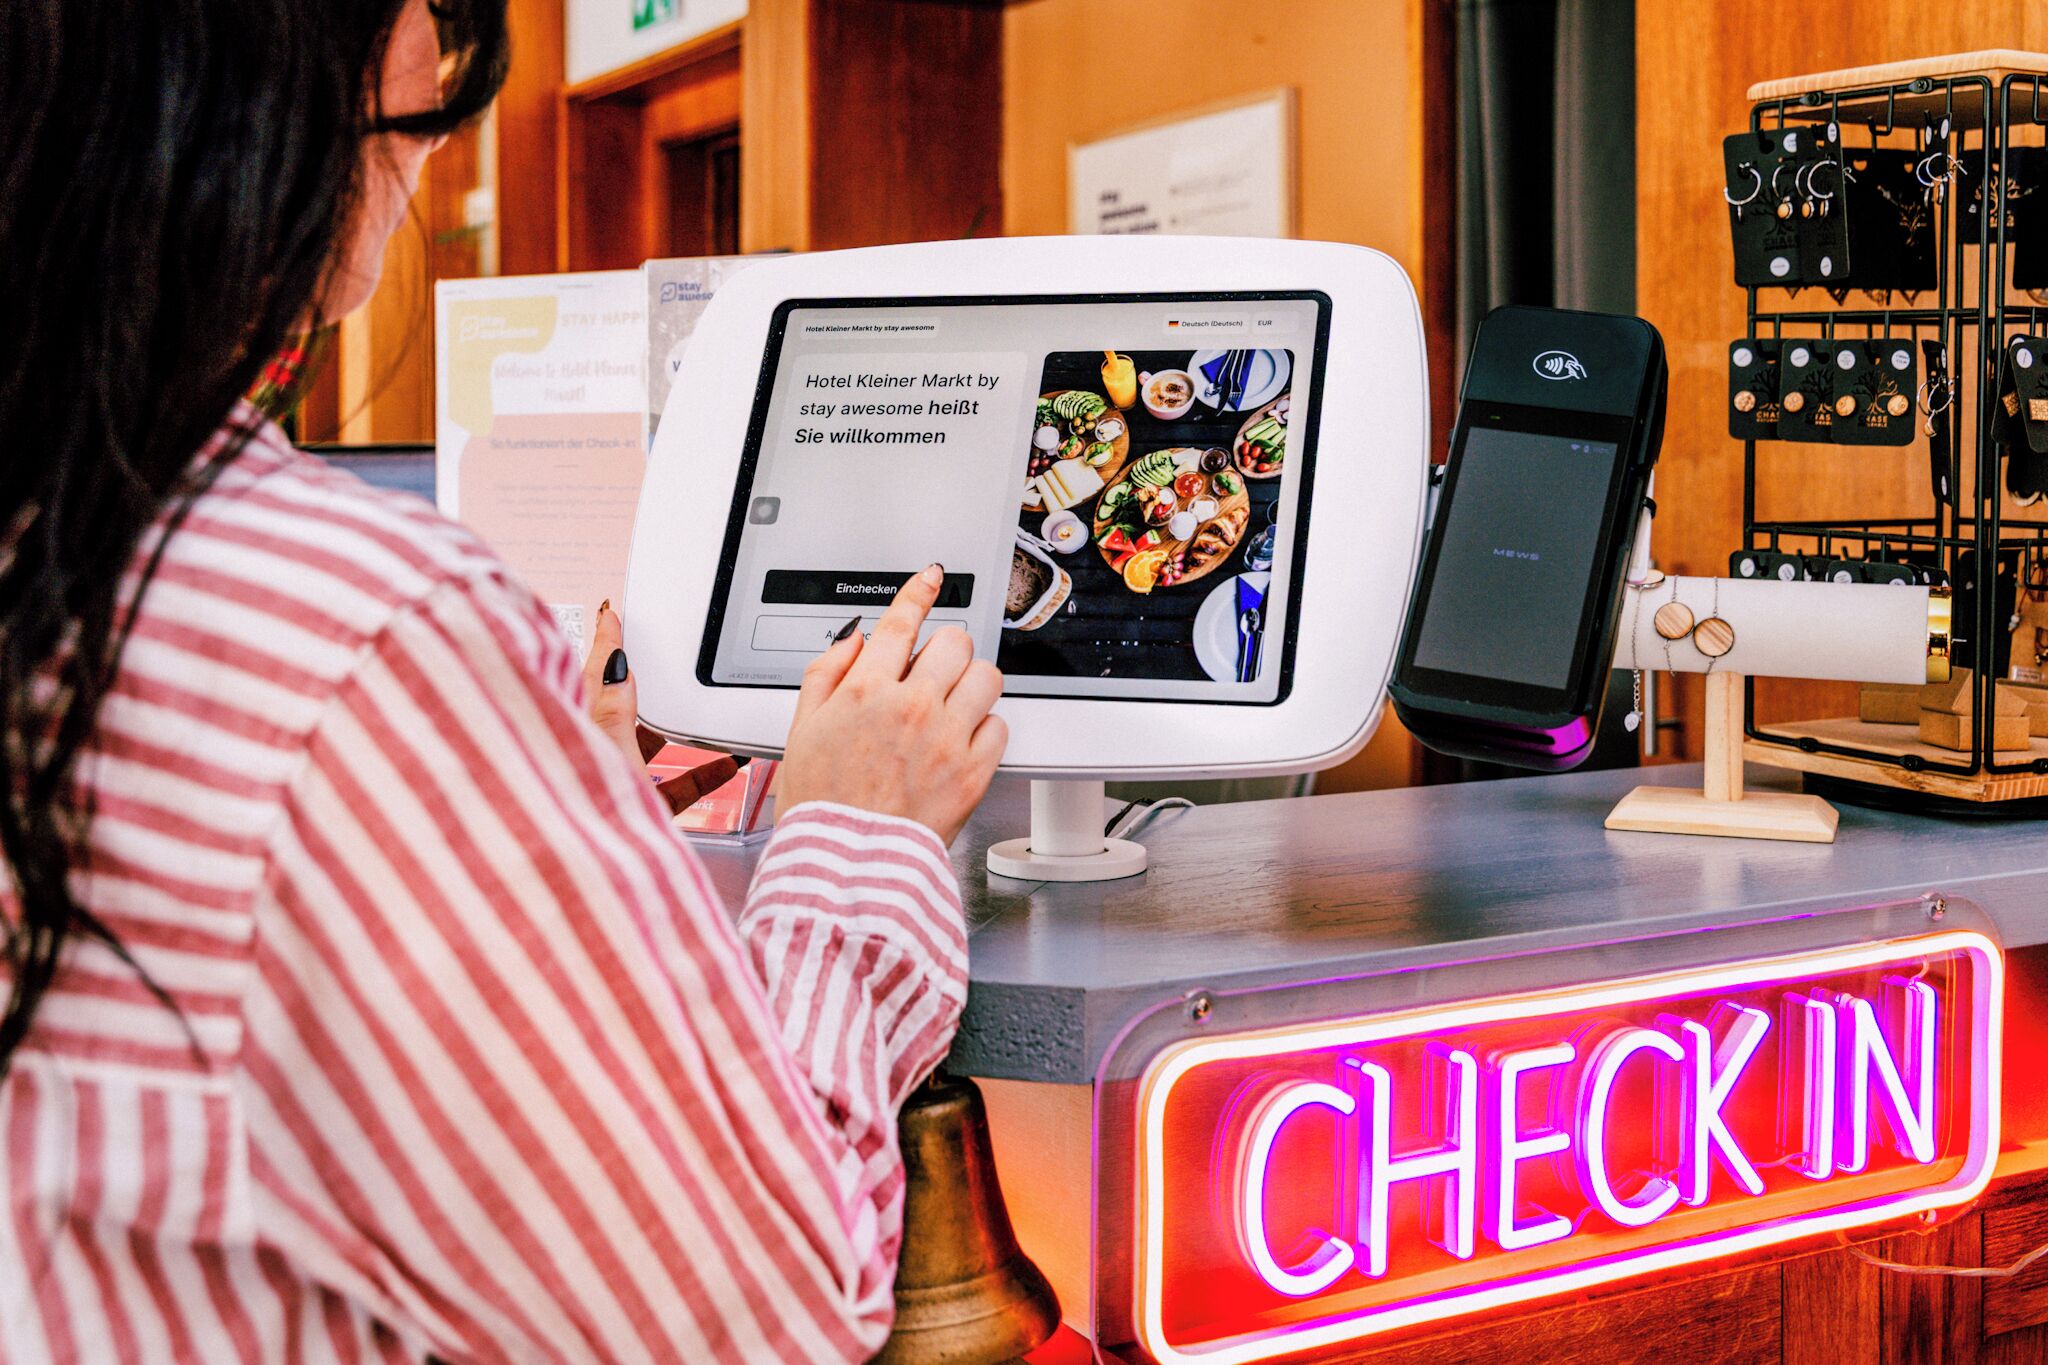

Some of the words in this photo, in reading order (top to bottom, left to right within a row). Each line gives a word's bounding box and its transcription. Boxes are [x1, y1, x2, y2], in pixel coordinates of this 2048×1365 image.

[678, 281, 702, 292] stay
[677, 292, 714, 301] aweso
[602, 312, 641, 326] HAPP
[1210, 320, 1243, 328] (Deutsch)
[805, 325, 825, 333] Hotel
[825, 325, 851, 333] Kleiner
[873, 324, 883, 334] by
[884, 325, 899, 333] stay
[806, 374, 852, 388] Hotel
[856, 374, 917, 388] Kleiner
[921, 373, 973, 388] Markt
[978, 373, 1000, 390] by
[800, 403, 836, 419] stay
[841, 404, 923, 415] awesome
[928, 400, 980, 415] heißt
[795, 428, 824, 444] Sie
[830, 428, 946, 444] willkommen
[1493, 548, 1541, 561] MEWS
[836, 583, 898, 594] Einchecken
[1243, 1002, 1772, 1298] CHECK
[1800, 975, 1939, 1182] IN
